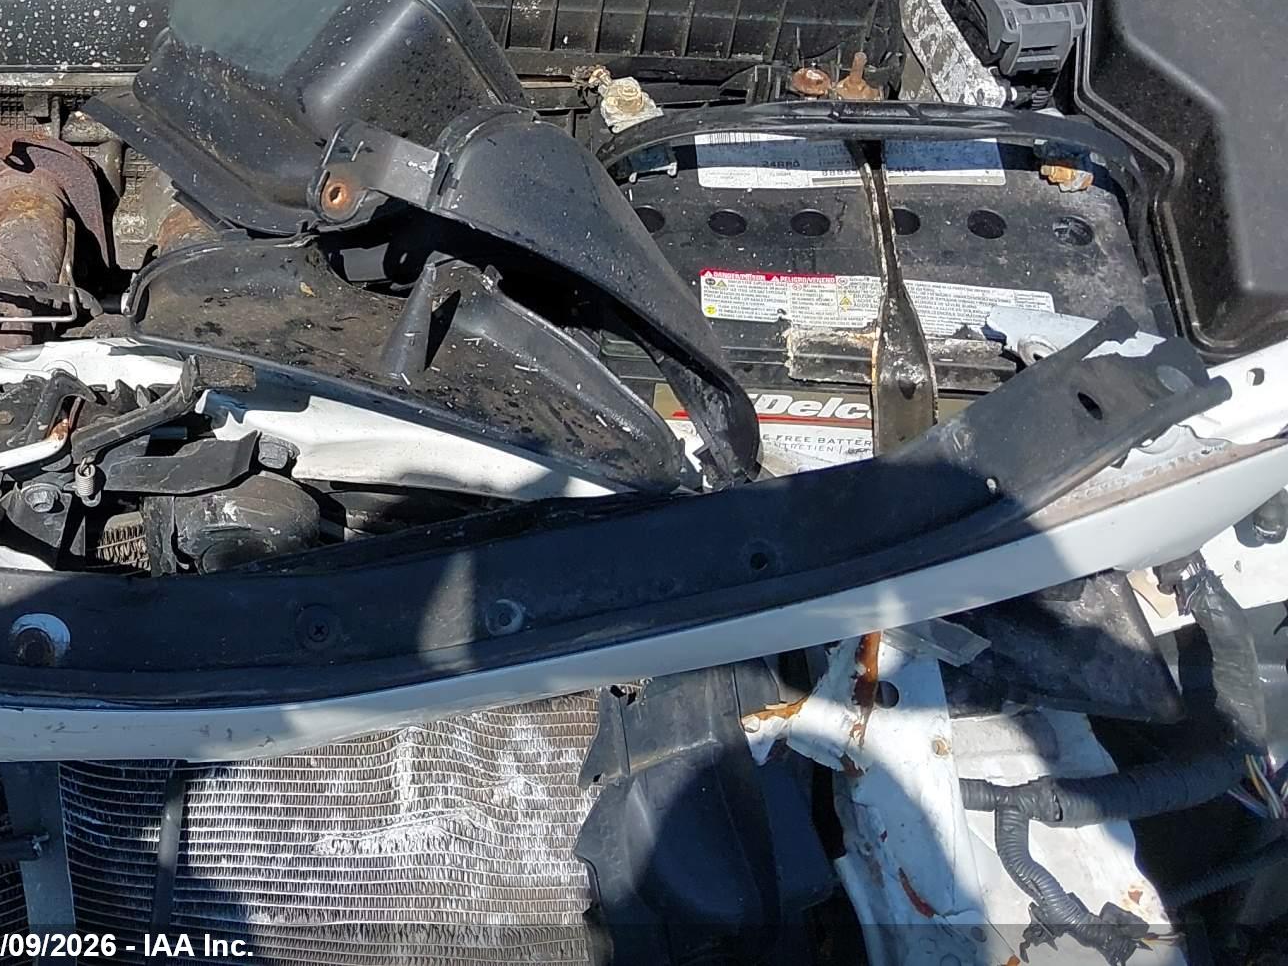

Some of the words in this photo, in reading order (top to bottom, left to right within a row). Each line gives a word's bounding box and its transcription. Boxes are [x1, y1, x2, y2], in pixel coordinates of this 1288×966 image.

[748, 394, 872, 419] Delc
[776, 434, 812, 444] FREE
[817, 437, 872, 446] BATTER
